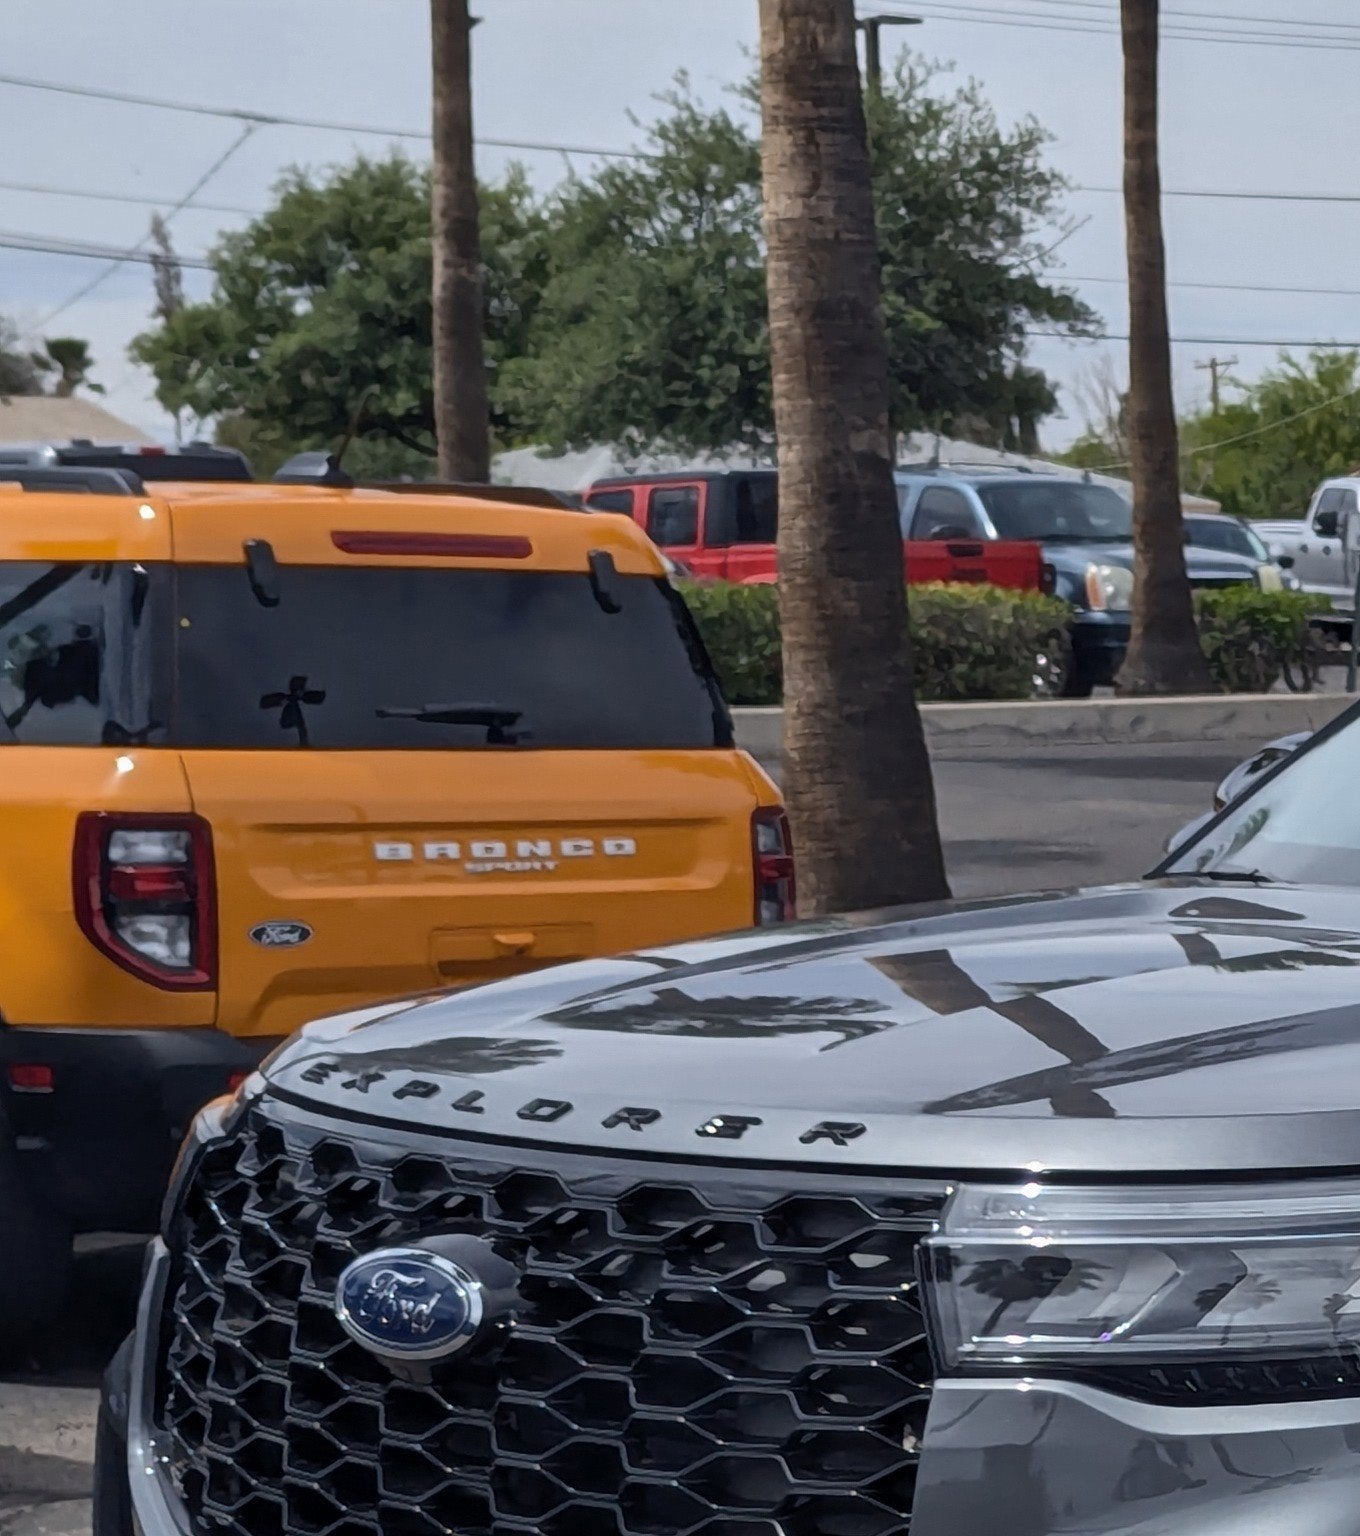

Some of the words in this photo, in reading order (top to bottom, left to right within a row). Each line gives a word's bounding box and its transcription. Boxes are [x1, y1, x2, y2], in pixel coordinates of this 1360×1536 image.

[373, 837, 636, 860] BRONCO
[464, 860, 559, 875] SPORT
[299, 1060, 868, 1148] EXPLORER
[360, 1268, 442, 1335] Ford
